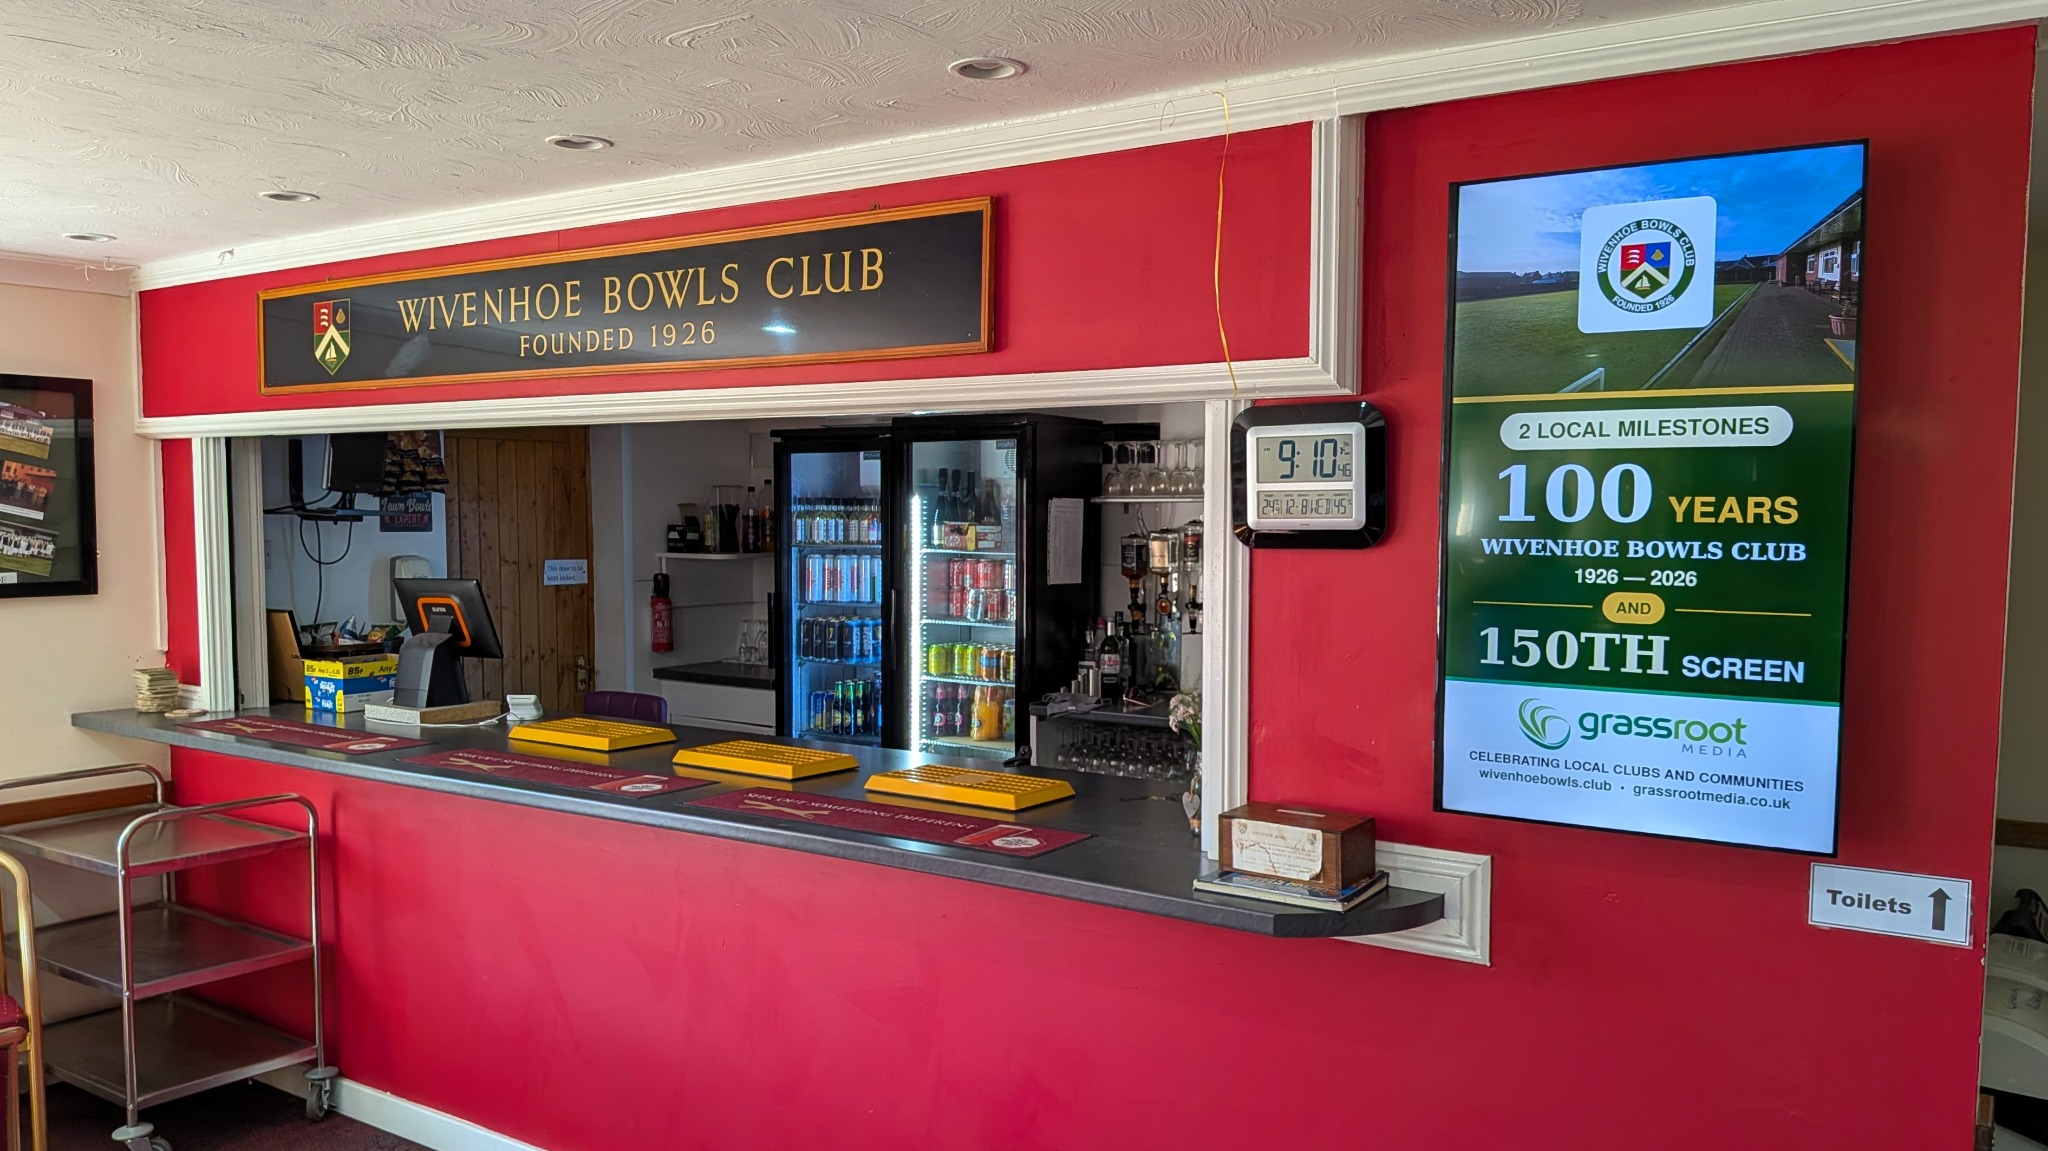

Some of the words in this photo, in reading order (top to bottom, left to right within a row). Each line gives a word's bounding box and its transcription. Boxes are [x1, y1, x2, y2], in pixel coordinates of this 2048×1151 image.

[1598, 222, 1639, 274] WIVENHOE
[1641, 220, 1682, 238] BOWLS
[1680, 237, 1694, 267] CLUB
[397, 280, 581, 334] WIVENHOE
[604, 263, 740, 314] BOWLS
[765, 247, 885, 300] CLUB
[1612, 296, 1654, 312] FOUNDED
[1655, 294, 1675, 309] 1926
[519, 328, 633, 358] FOUNDED
[651, 320, 716, 346] 1926
[1518, 424, 1530, 440] 2
[1537, 421, 1610, 439] LOCAL
[1618, 417, 1770, 438] MILESTONES
[1338, 463, 1352, 477] 46
[1498, 463, 1653, 523] 100
[1668, 496, 1799, 525] YEARS
[394, 514, 422, 524] EXPERT
[1480, 538, 1619, 558] WIVENHOE
[1627, 540, 1723, 560] BOWLS
[1731, 542, 1807, 562] CLUB
[1574, 568, 1618, 584] 1926
[1650, 570, 1698, 587] 2026
[1616, 602, 1652, 615] AND
[378, 664, 393, 672] Any
[1479, 626, 1670, 675] 150TH
[1681, 655, 1806, 683] SCREEN
[1578, 710, 1748, 746] grassroot
[1681, 744, 1748, 759] MEDIA
[1469, 750, 1560, 769] CELEBRATING
[1564, 760, 1610, 774] LOCAL
[1613, 764, 1660, 779] CLUBS
[1664, 769, 1695, 782] AND
[1699, 772, 1804, 792] COMMUNITIES
[1478, 768, 1612, 792] wivenhoebowls.club
[1632, 784, 1791, 810] grassrootmedia.co.uk
[808, 802, 892, 818] SOMETHING
[894, 814, 978, 830] DIFFERENT
[1826, 888, 1912, 915] Toilets
